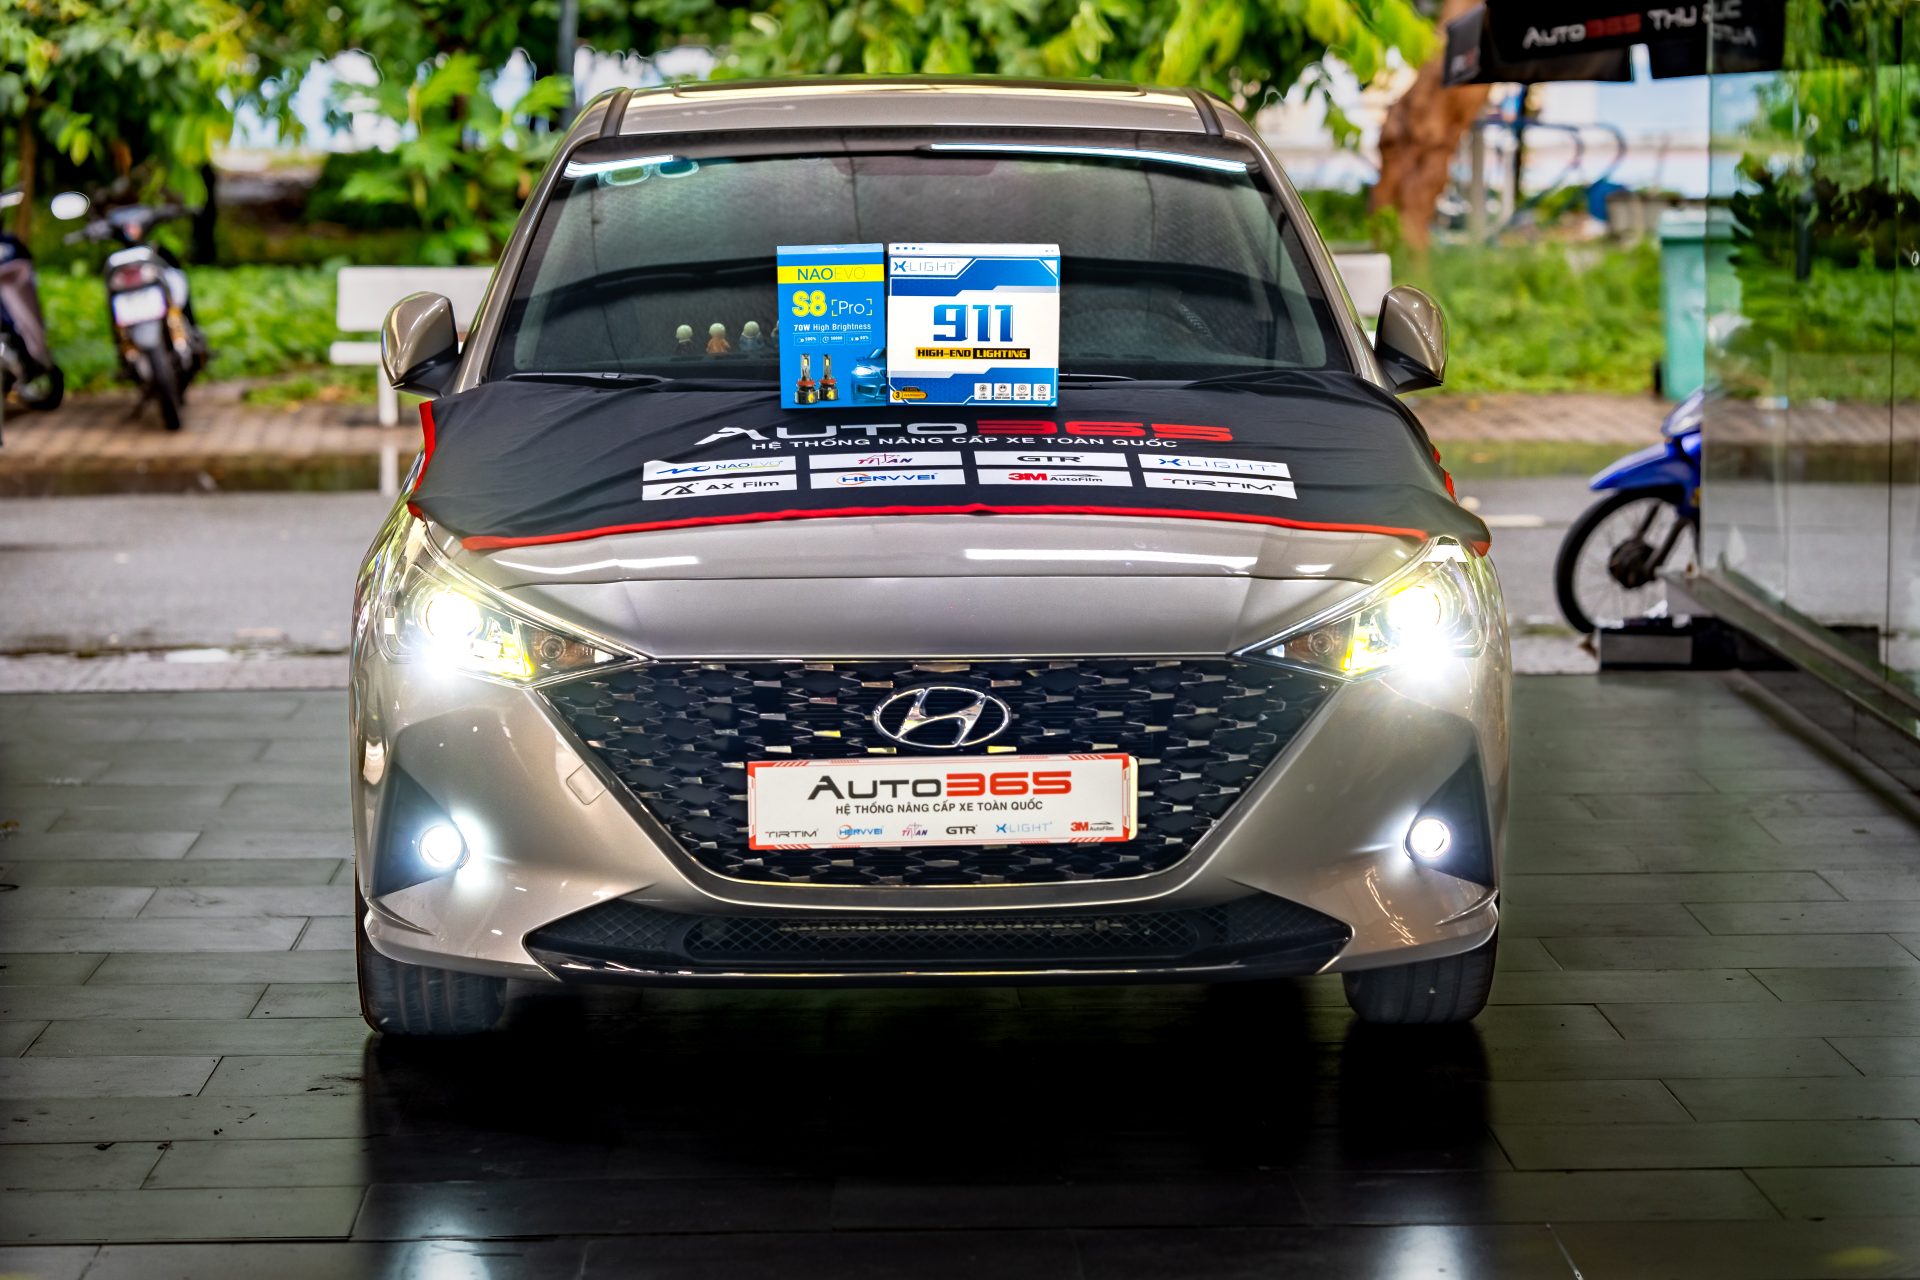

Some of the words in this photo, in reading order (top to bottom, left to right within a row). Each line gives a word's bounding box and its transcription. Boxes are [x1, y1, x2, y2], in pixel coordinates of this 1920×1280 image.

[792, 290, 827, 317] S8
[793, 324, 811, 332] 70W
[813, 323, 830, 332] High
[832, 322, 872, 332] Brightness
[933, 304, 1013, 342] 911
[917, 348, 972, 358] HIGH-END
[976, 348, 1027, 358] LIGHTING
[1041, 436, 1105, 446] TOÀN
[1017, 455, 1080, 463] GTR
[1008, 473, 1047, 481] 3M
[706, 483, 734, 491] AX
[808, 771, 1072, 800] AUTO365
[836, 805, 851, 816] HỆ
[959, 802, 974, 811] XE
[978, 799, 1008, 811] TOÀN
[946, 826, 975, 834] GTR
[1070, 822, 1088, 832] 3M
